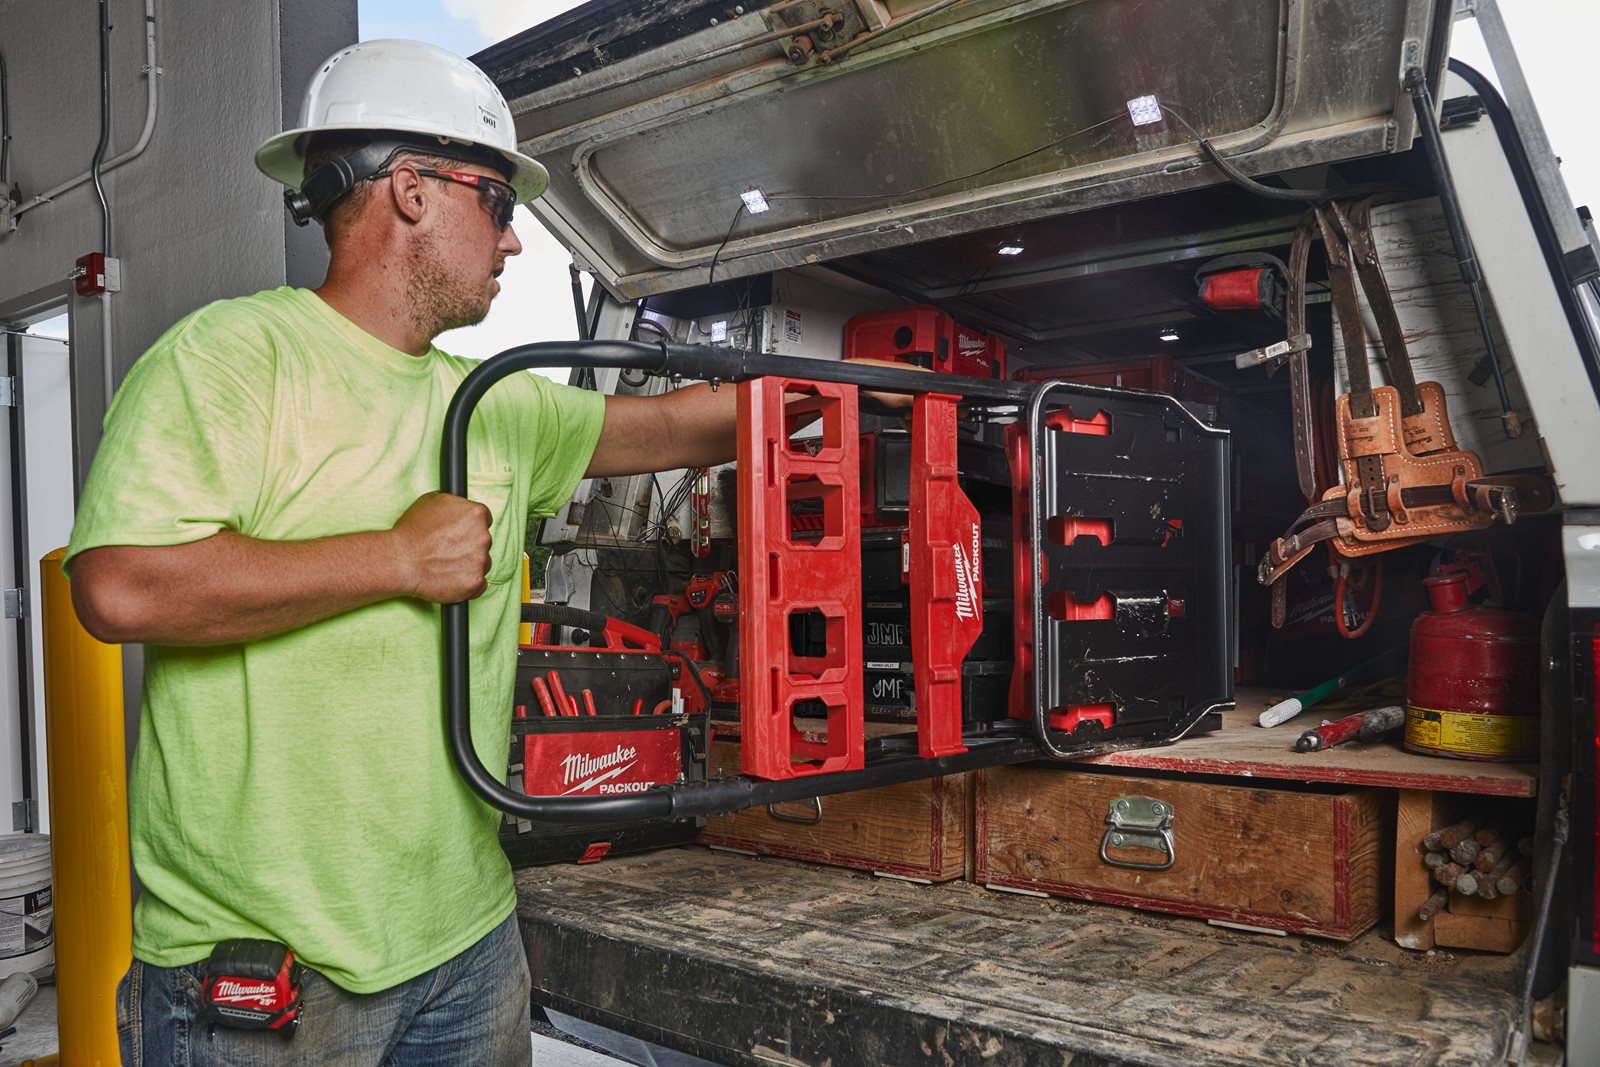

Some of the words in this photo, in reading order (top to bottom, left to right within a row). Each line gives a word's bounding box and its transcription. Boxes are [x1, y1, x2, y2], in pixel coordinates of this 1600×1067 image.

[483, 115, 496, 128] 001
[953, 543, 974, 622] Milwaukee
[560, 745, 637, 785] Milwaukee
[217, 981, 275, 996] Milwaukee
[221, 1009, 267, 1019] MAGNETIC
